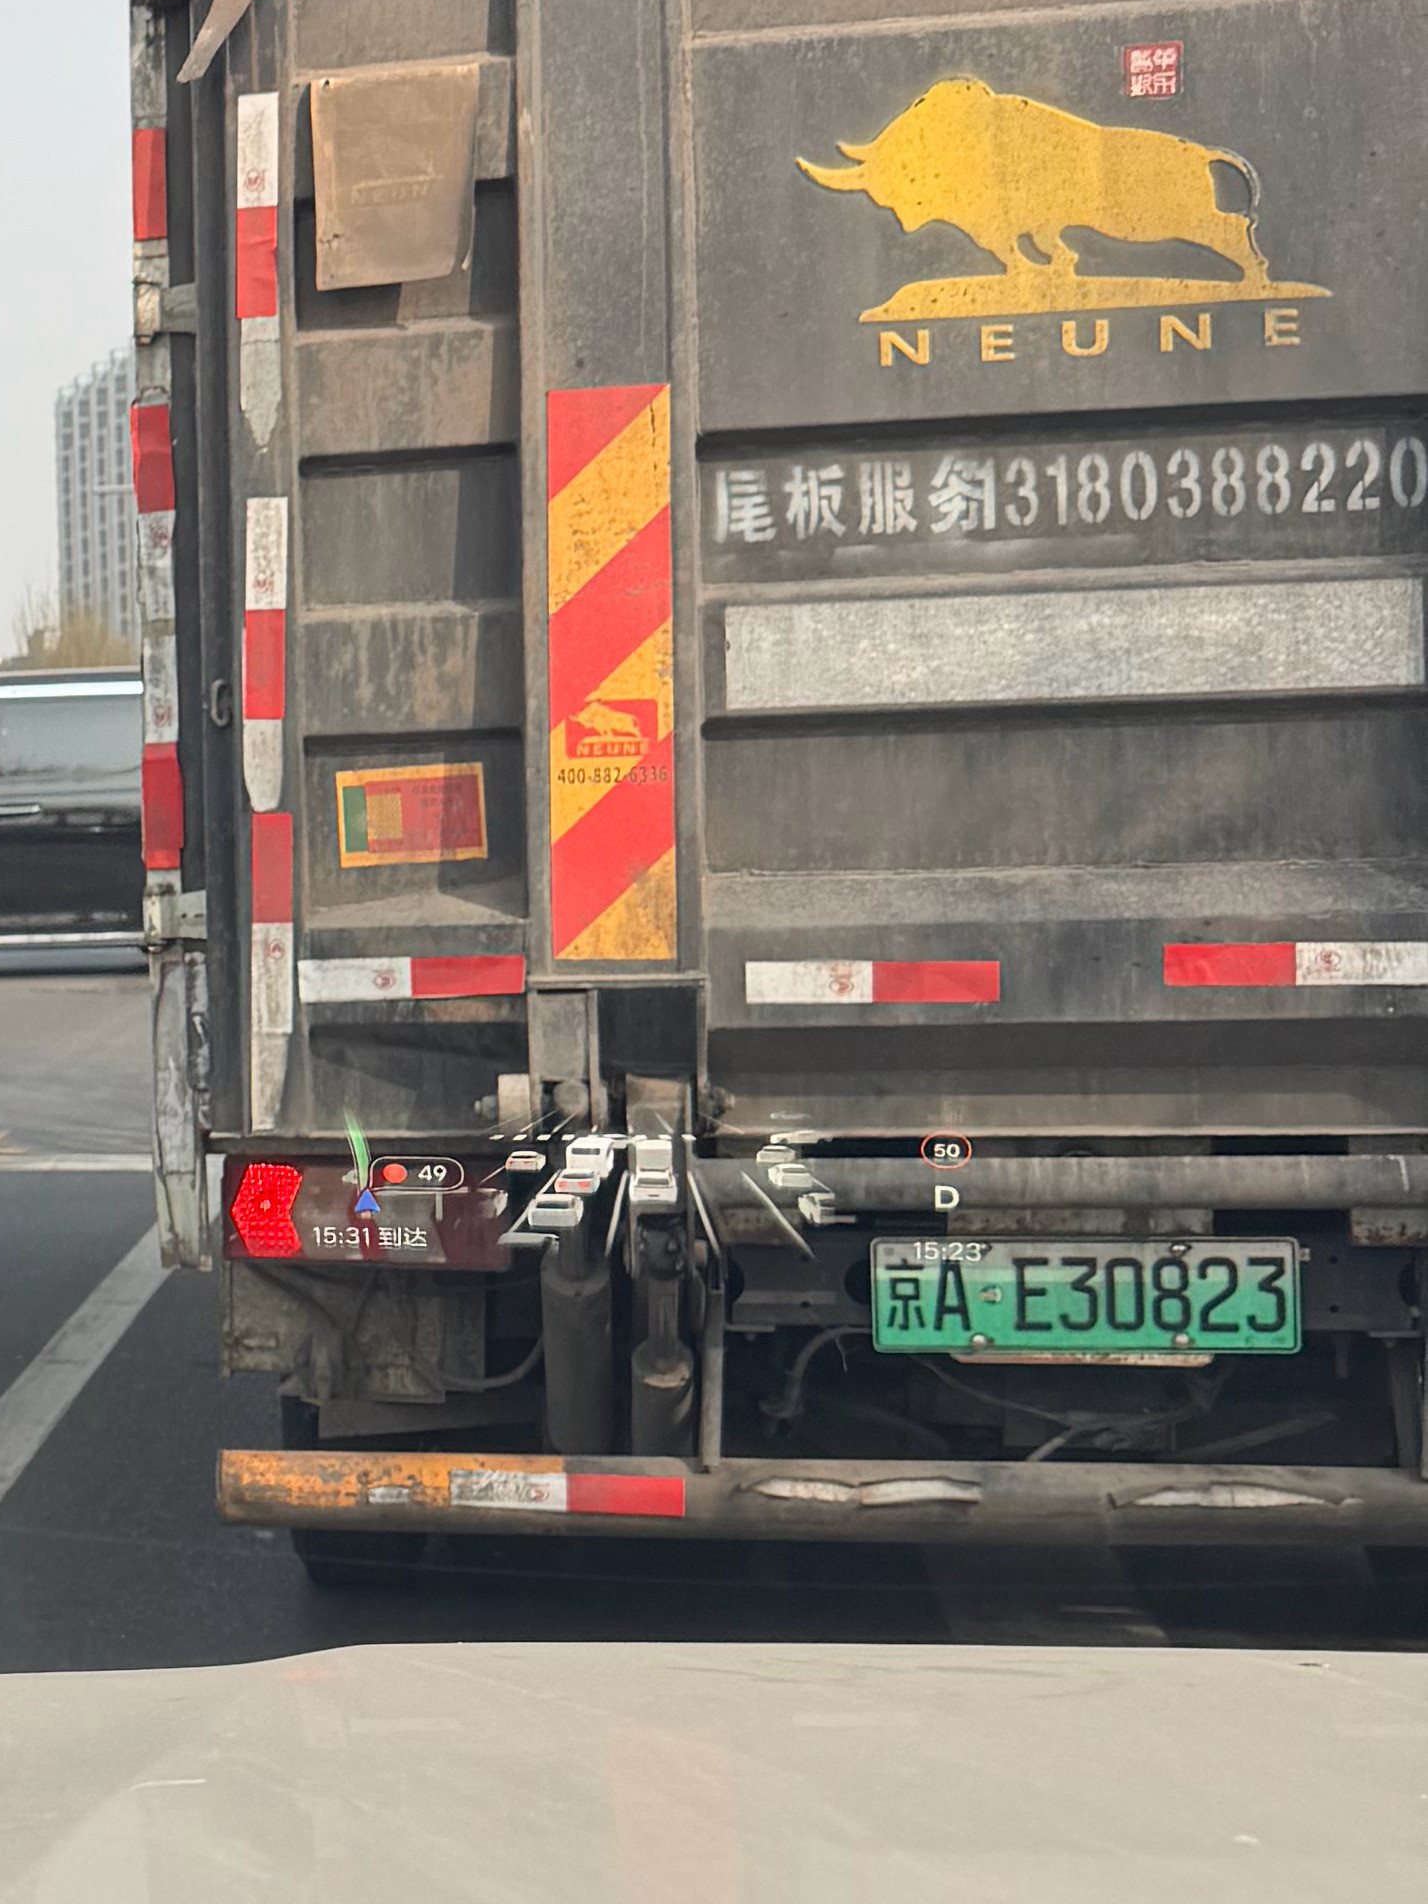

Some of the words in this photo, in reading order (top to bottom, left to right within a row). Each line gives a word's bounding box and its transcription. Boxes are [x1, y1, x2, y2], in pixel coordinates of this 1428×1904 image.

[879, 307, 1301, 367] NEUNE
[577, 741, 650, 757] NEUNE
[934, 1143, 961, 1159] 50
[417, 1164, 448, 1183] 49
[934, 1185, 960, 1211] D
[312, 1226, 371, 1246] 15:31
[378, 1226, 428, 1248] 到达
[913, 1241, 982, 1262] 15:23
